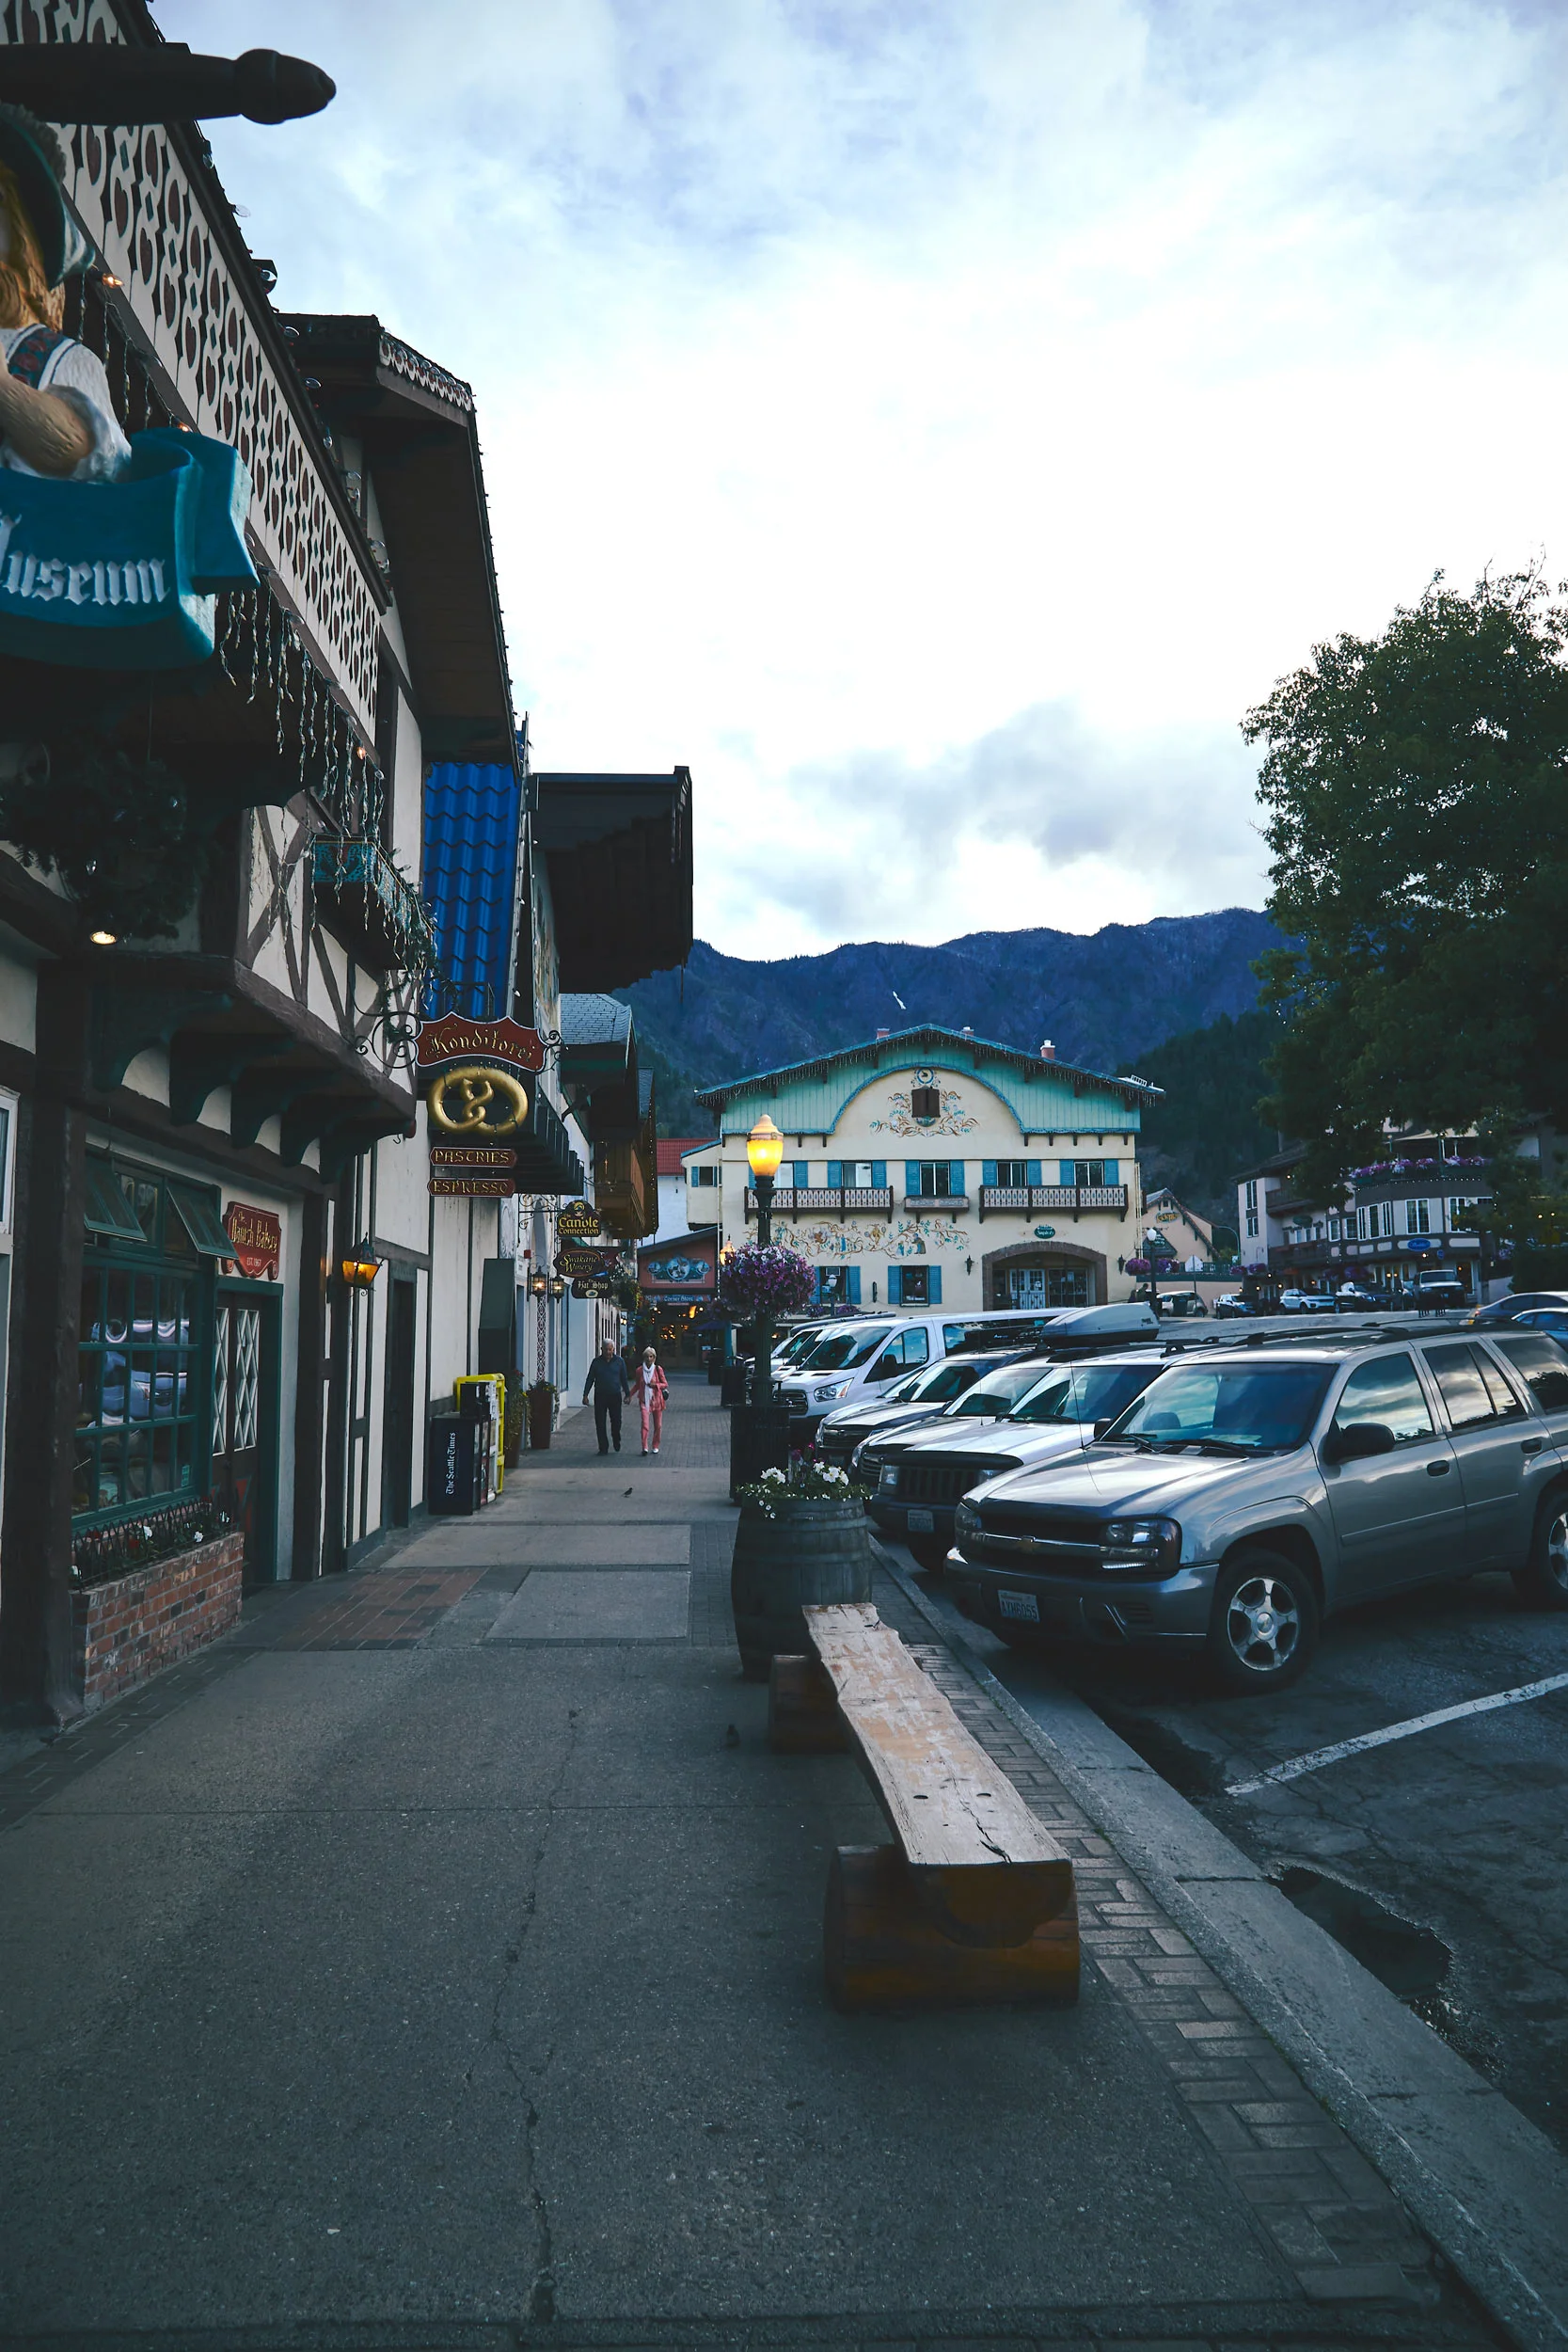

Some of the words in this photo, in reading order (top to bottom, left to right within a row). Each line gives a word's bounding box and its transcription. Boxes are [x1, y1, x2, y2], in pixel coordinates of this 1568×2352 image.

[424, 1023, 536, 1063] Konditorei
[434, 1150, 511, 1164] PASTRIES
[433, 1180, 509, 1194] ESPRESSO
[559, 1216, 599, 1228] Candle
[256, 1219, 278, 1254] Bakery
[560, 1254, 597, 1265] Swakane
[565, 1263, 593, 1273] Winery
[578, 1280, 590, 1290] Hat
[592, 1281, 609, 1290] Shop
[447, 1432, 456, 1455] Times
[445, 1455, 455, 1480] Seattle
[445, 1480, 454, 1495] The
